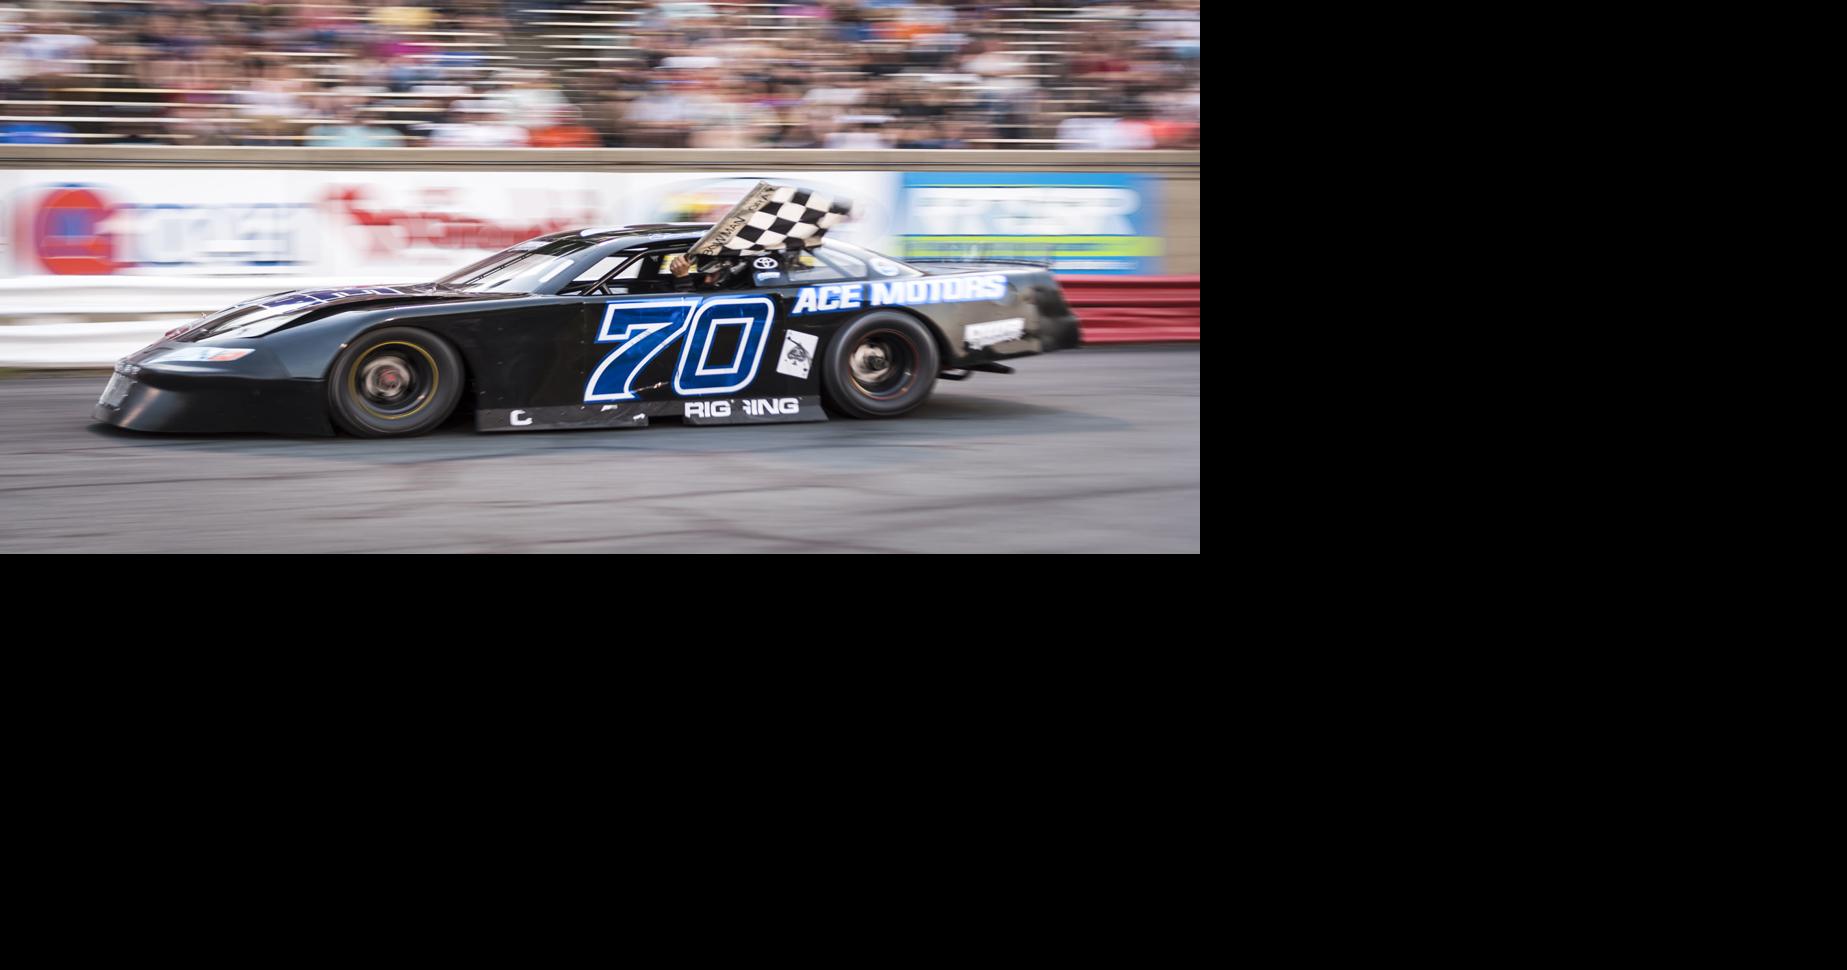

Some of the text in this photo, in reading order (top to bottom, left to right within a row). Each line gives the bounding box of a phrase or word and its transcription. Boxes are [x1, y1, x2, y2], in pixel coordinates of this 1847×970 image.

[703, 216, 746, 256] BOWMAN
[790, 275, 1007, 314] ACE MOTORS
[583, 295, 775, 403] 70
